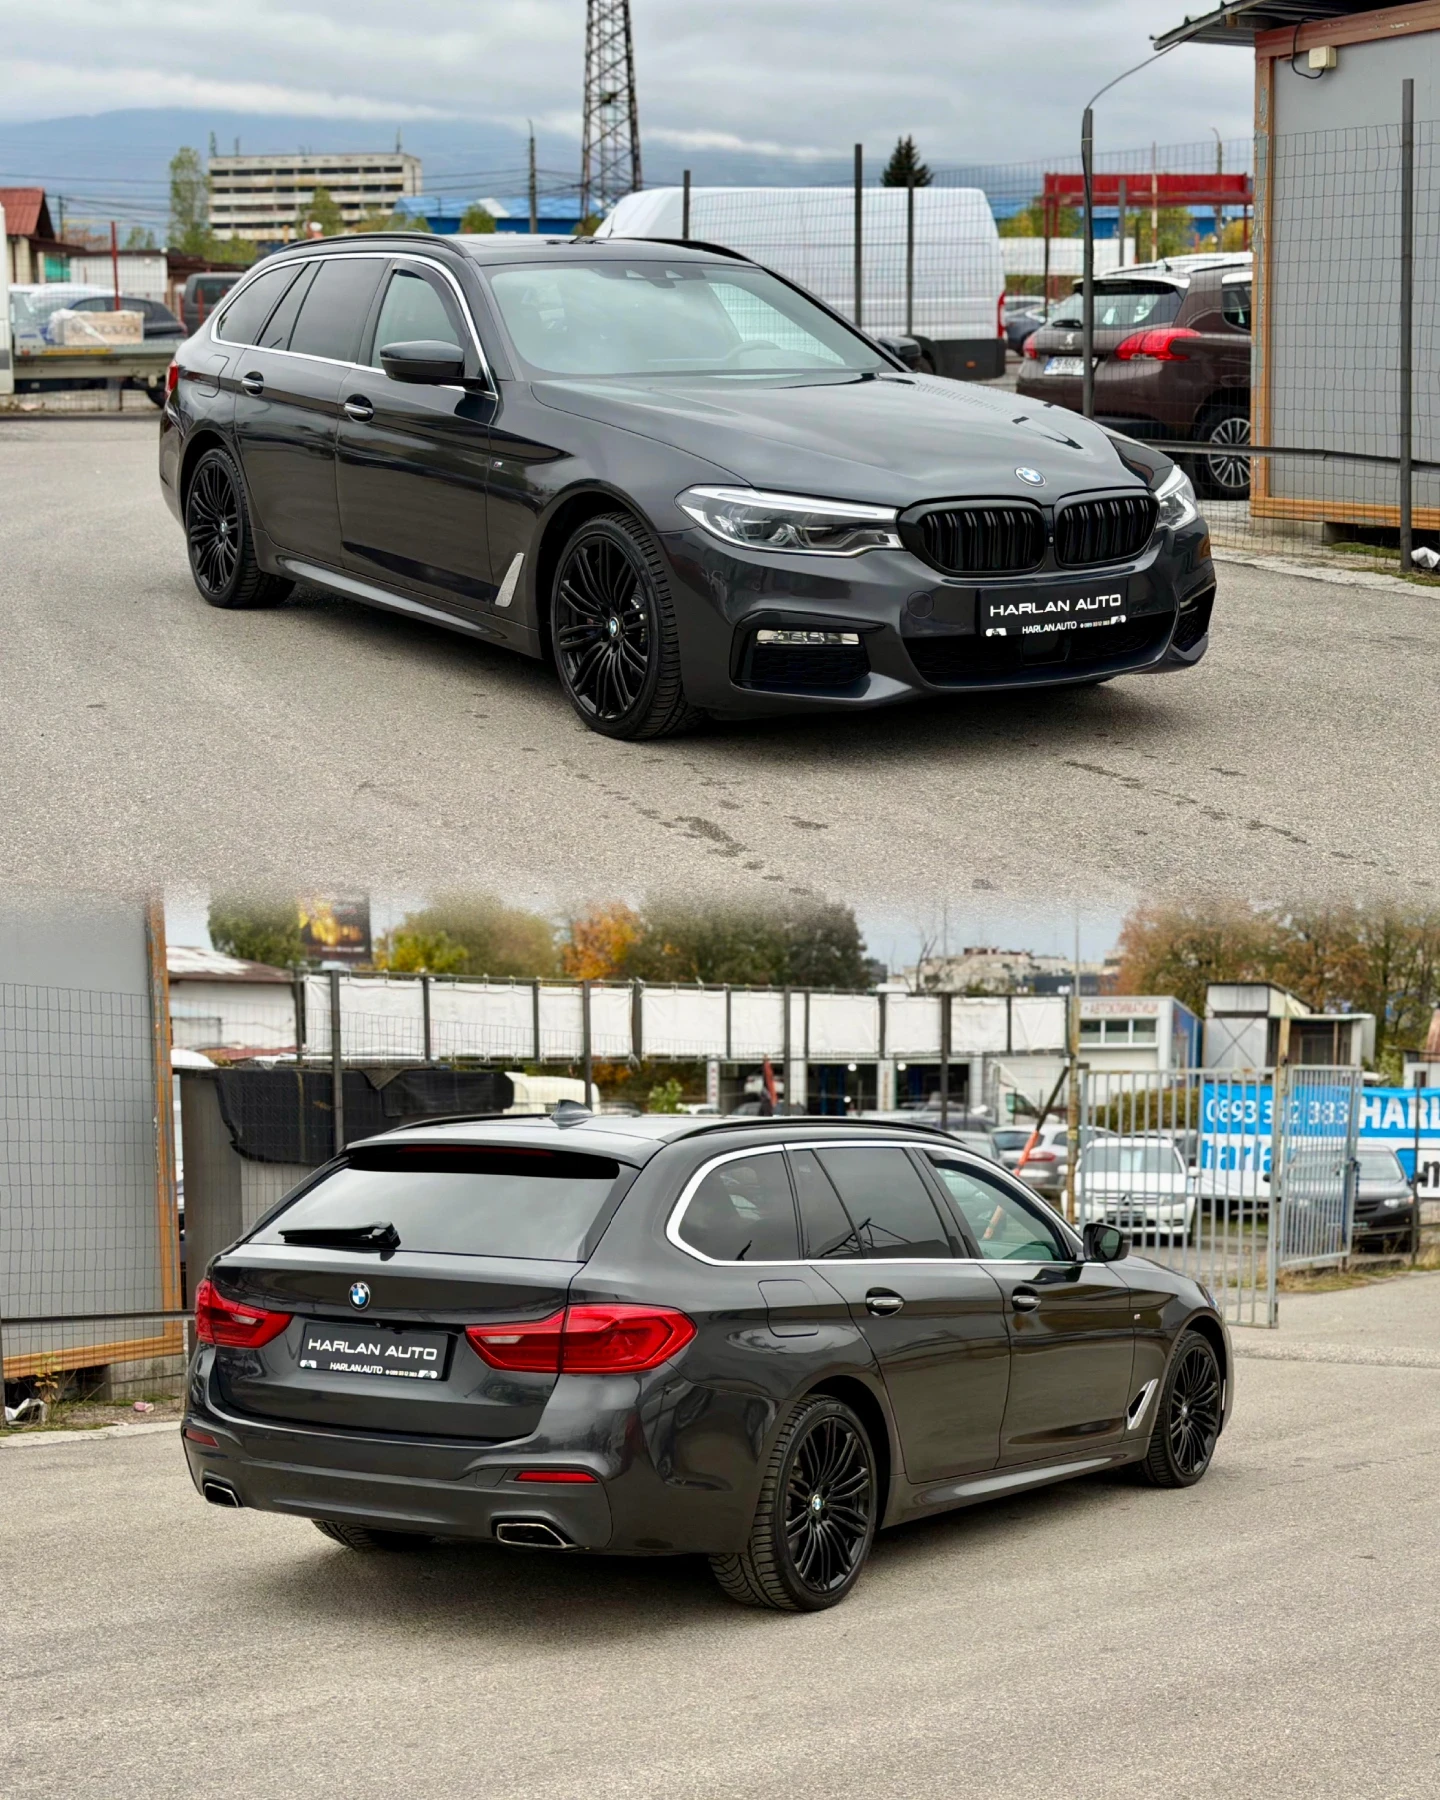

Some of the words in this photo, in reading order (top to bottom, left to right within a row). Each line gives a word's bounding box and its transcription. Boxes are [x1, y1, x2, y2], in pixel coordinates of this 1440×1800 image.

[990, 600, 1070, 617] HARLAN
[1075, 594, 1121, 611] AUTO
[1206, 1099, 1257, 1124] 0893
[308, 1338, 381, 1356] HARLAN
[385, 1345, 438, 1361] AUTO
